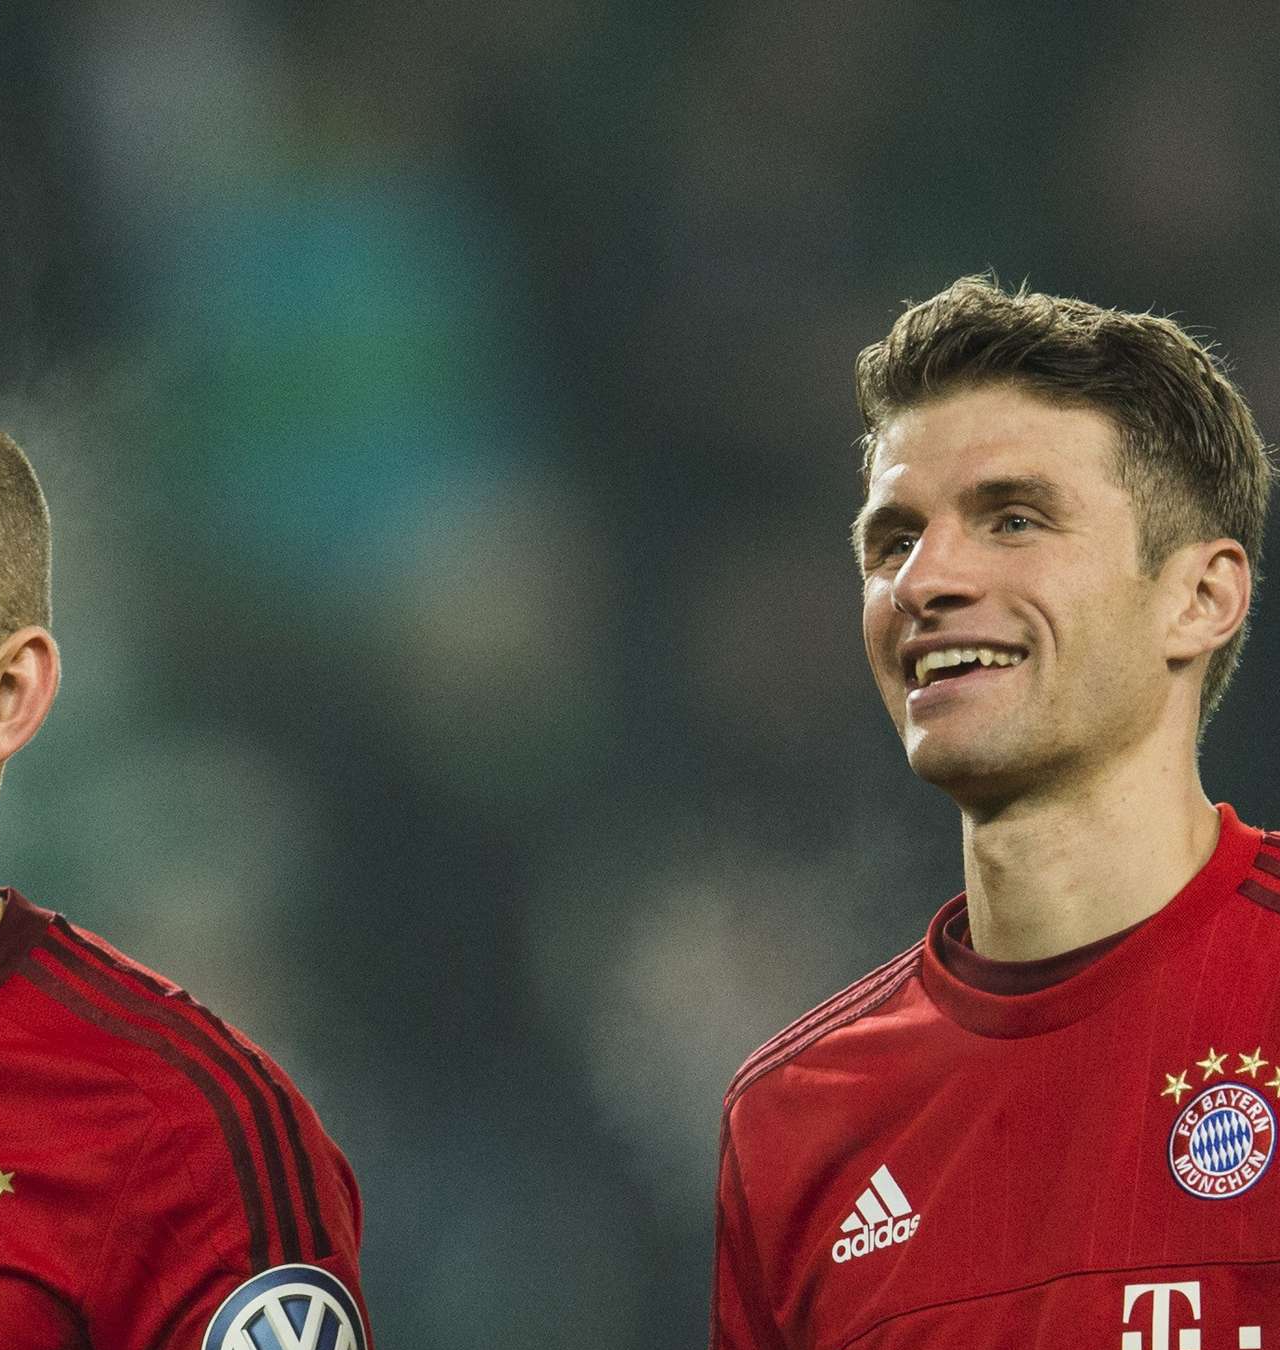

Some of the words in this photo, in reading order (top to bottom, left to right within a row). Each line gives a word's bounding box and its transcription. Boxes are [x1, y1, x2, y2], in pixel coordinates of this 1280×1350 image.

[1178, 1110, 1198, 1137] FC
[1201, 1090, 1269, 1133] BAYERN
[832, 1214, 921, 1263] adidas
